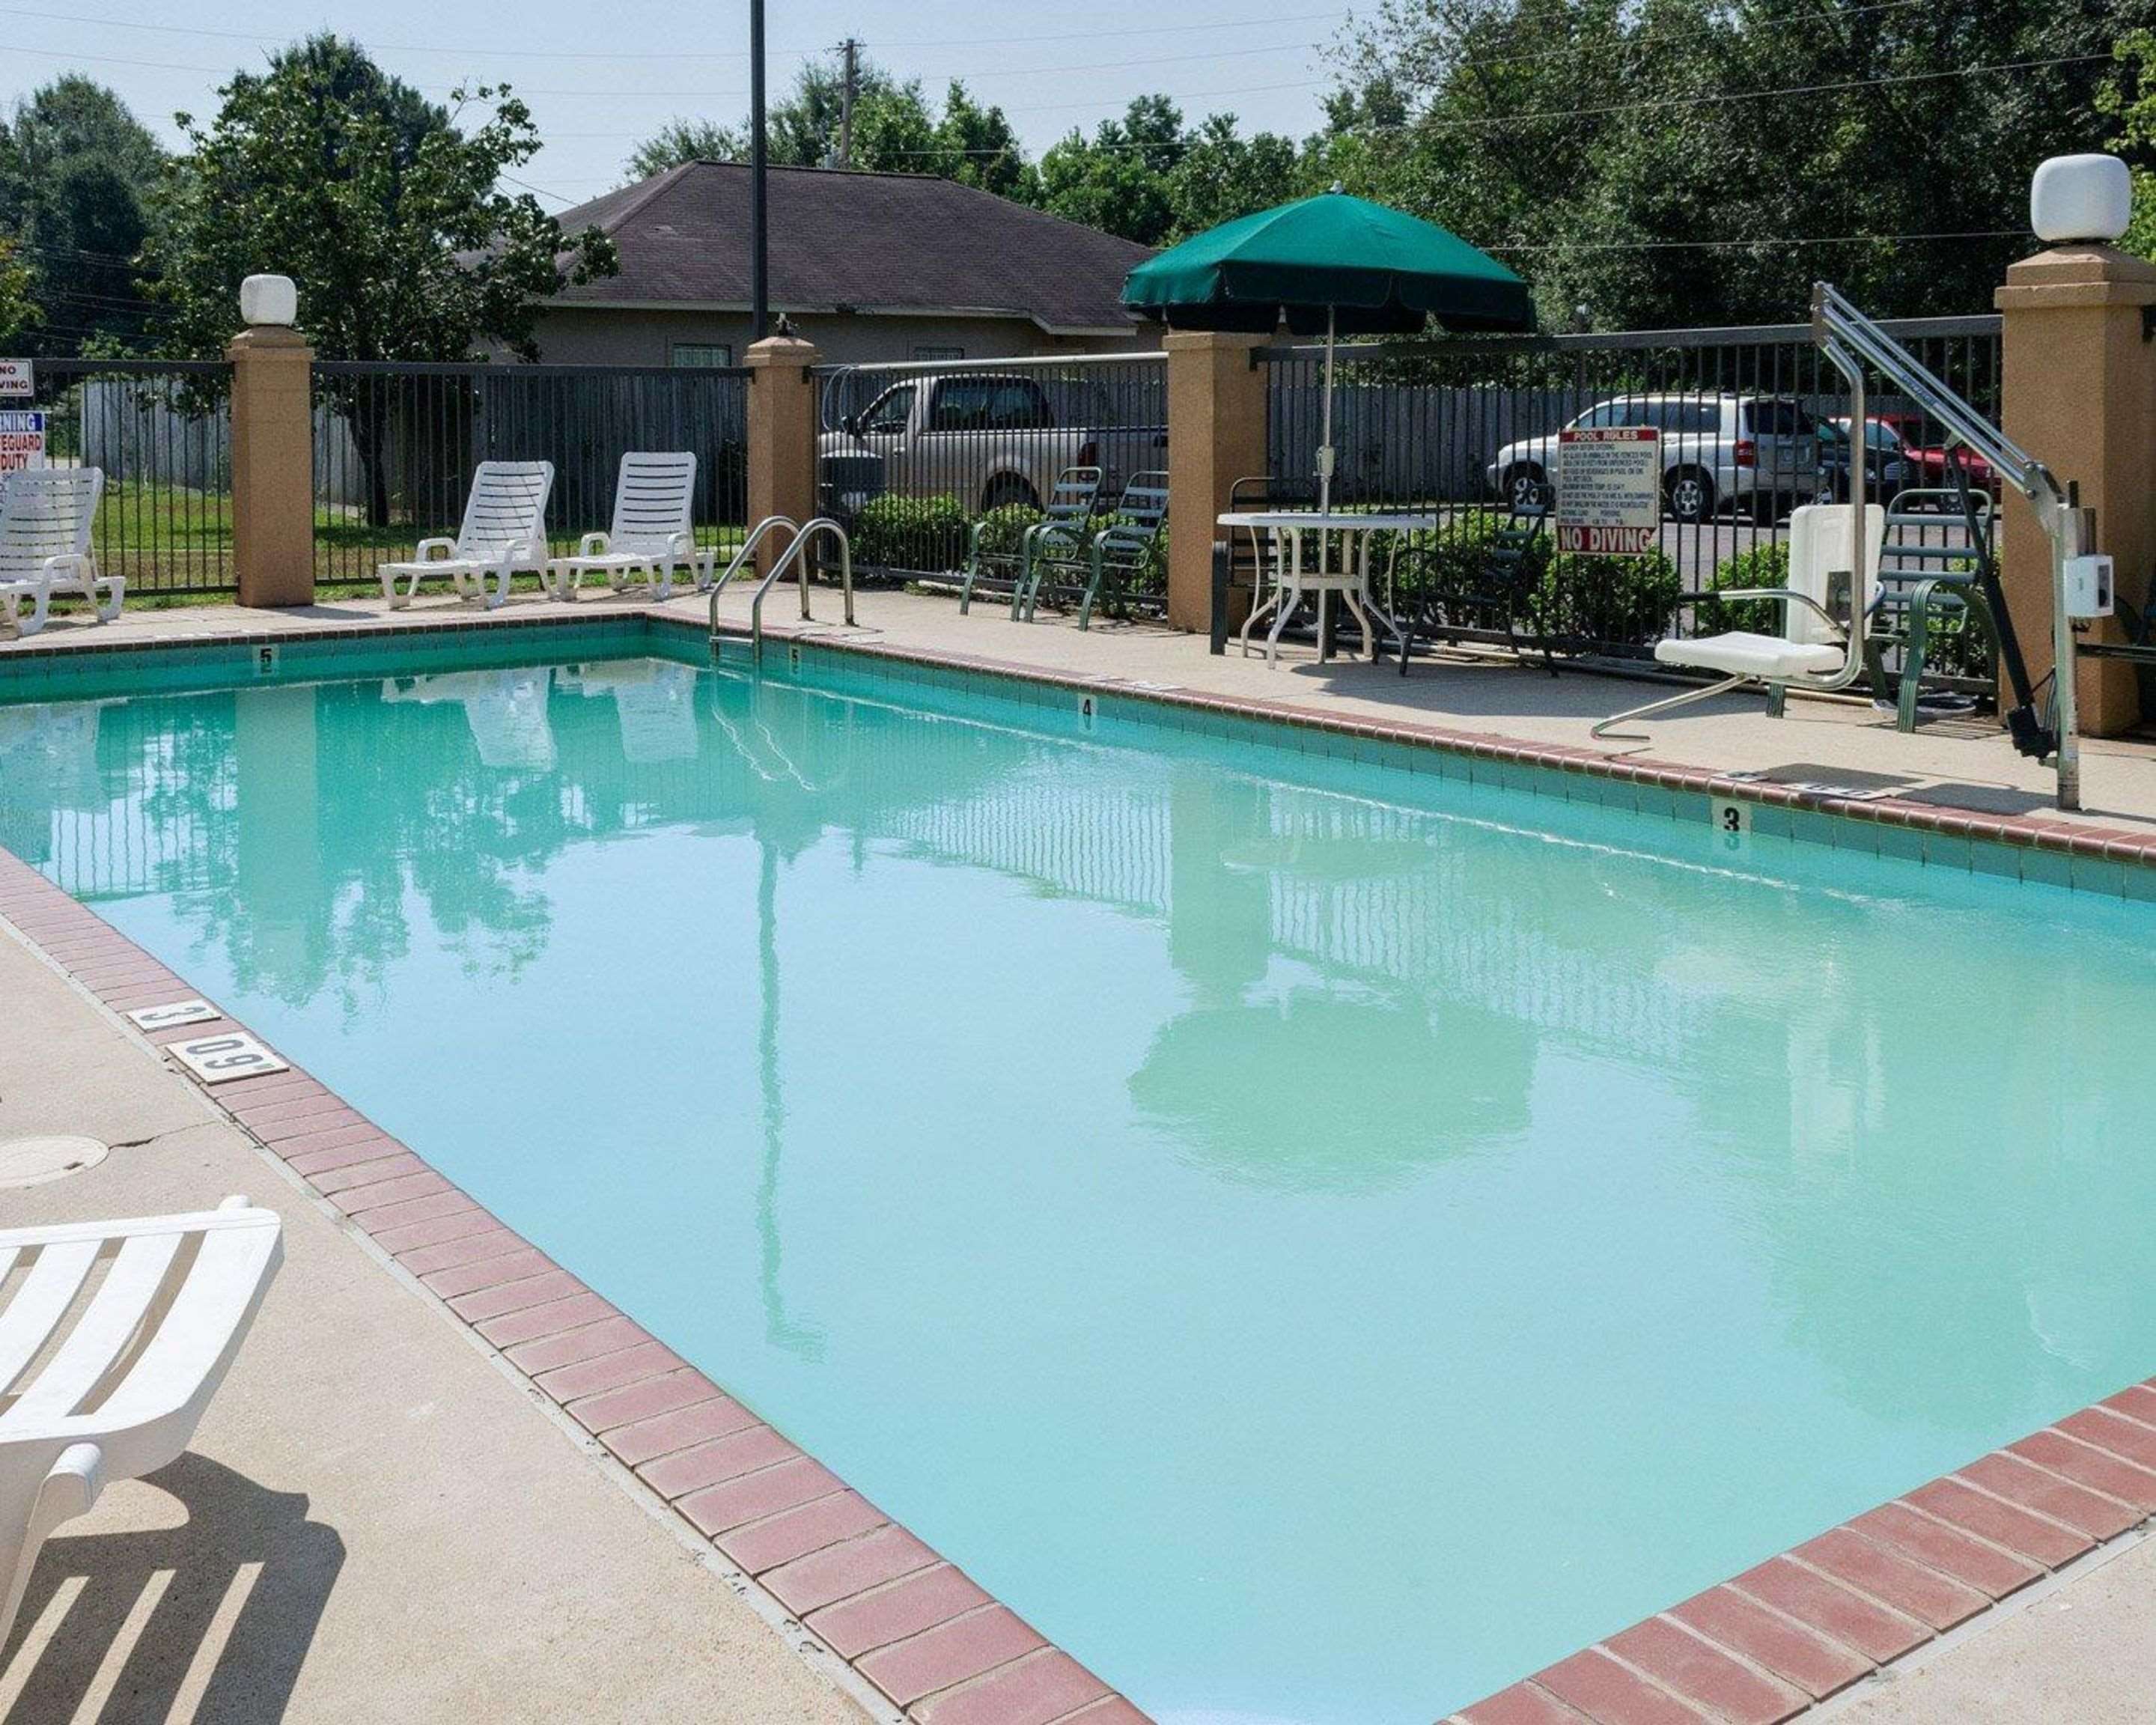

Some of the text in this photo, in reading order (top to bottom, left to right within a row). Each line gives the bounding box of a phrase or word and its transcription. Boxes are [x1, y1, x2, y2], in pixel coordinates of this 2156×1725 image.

[0, 434, 42, 451] EGUARD
[1574, 431, 1638, 442] POOL RULES
[1, 453, 28, 471] DUTY
[1561, 526, 1651, 553] NO DIVING
[261, 648, 272, 663] 5
[1724, 806, 1740, 831] 3
